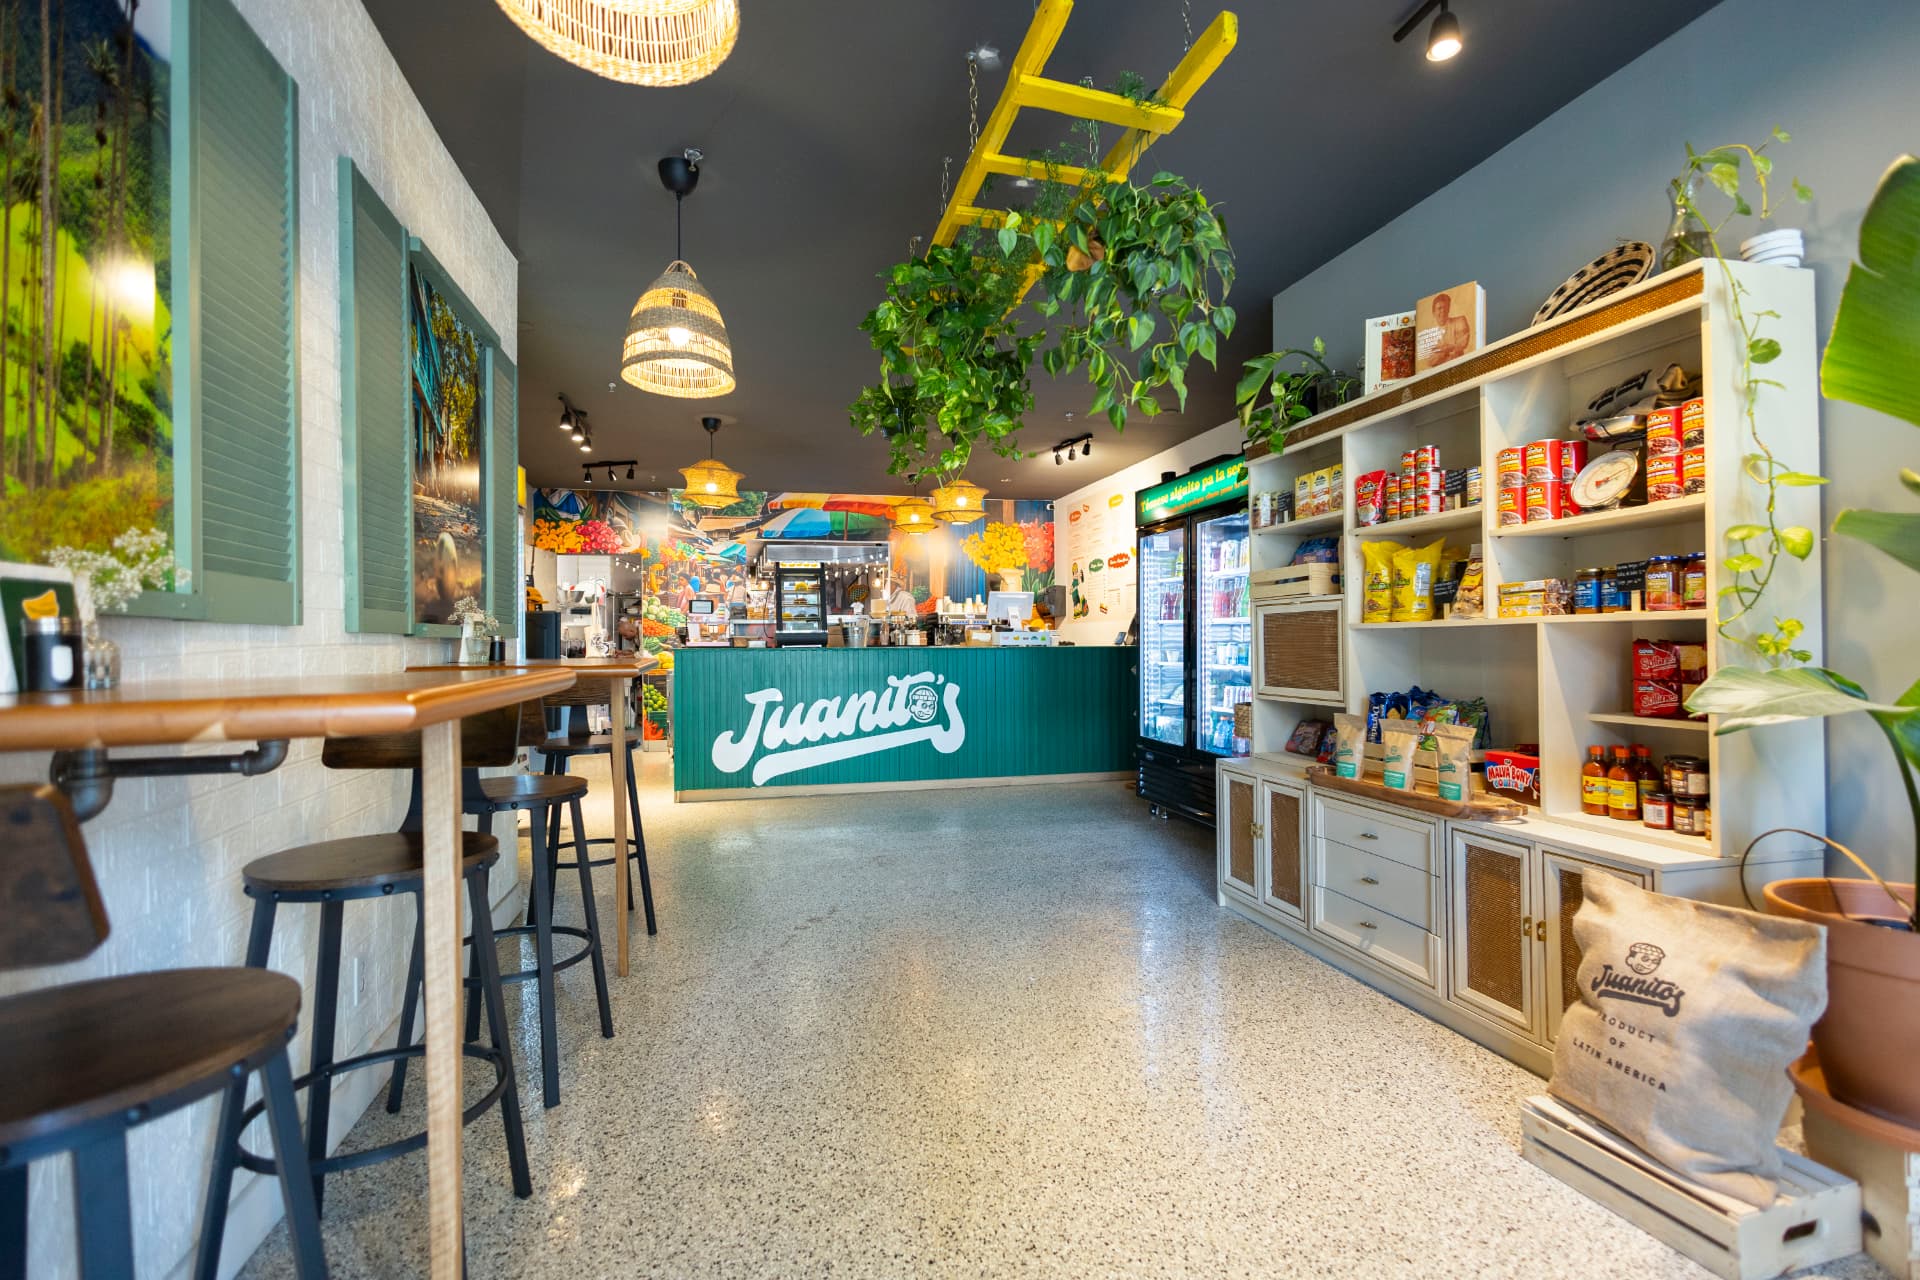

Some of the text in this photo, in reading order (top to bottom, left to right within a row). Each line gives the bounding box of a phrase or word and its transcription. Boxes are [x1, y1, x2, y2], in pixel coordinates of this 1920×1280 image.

[1487, 765, 1531, 786] MALVA BONY
[1591, 964, 1685, 1017] Juanito's
[1608, 1037, 1626, 1049] OF
[1572, 1038, 1667, 1092] LATIN AMERICA
